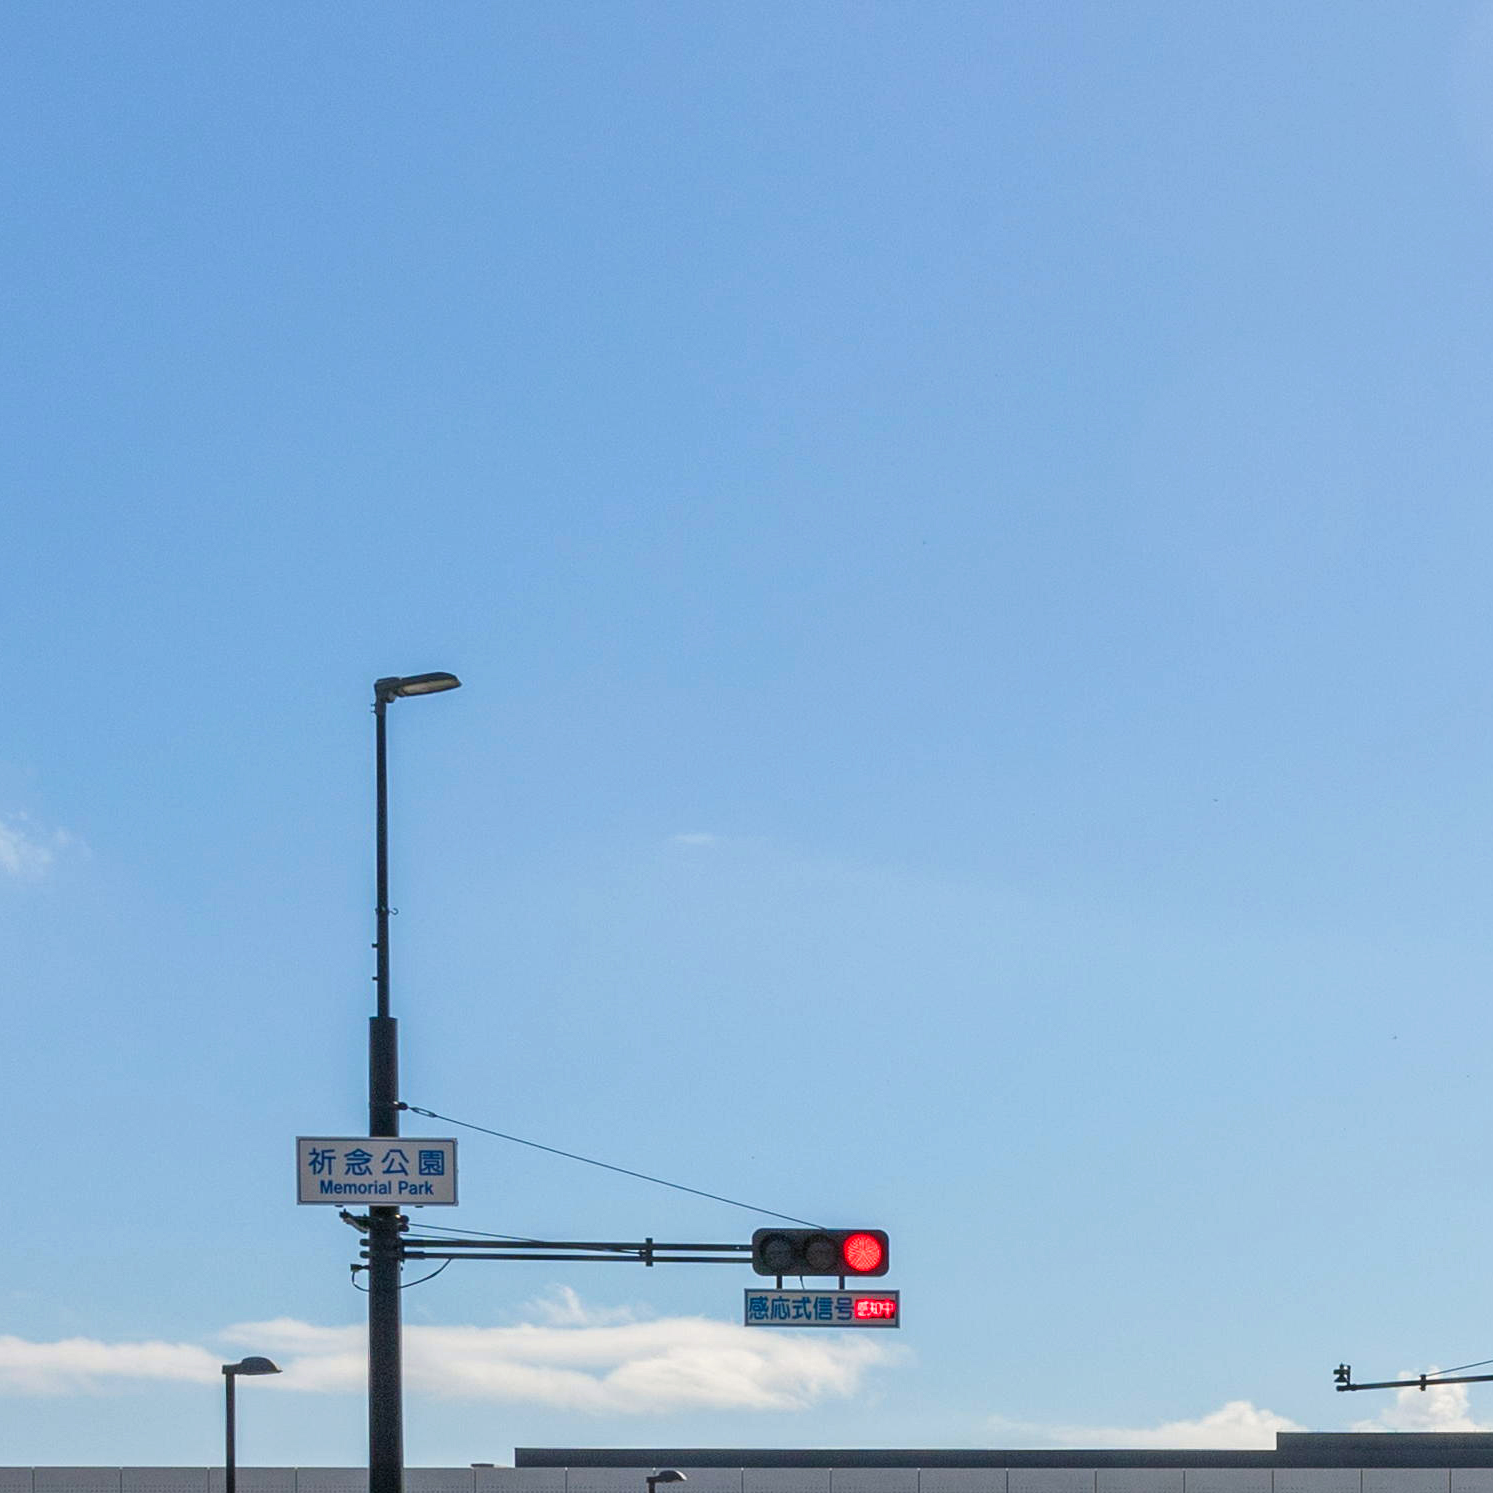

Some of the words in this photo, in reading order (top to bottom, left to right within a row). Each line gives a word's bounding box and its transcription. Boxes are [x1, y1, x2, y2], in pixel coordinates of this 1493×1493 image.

[308, 1148, 445, 1176] 祈念公園
[320, 1180, 392, 1195] Memorial
[398, 1180, 434, 1195] Park
[749, 1296, 853, 1321] 感応式信号
